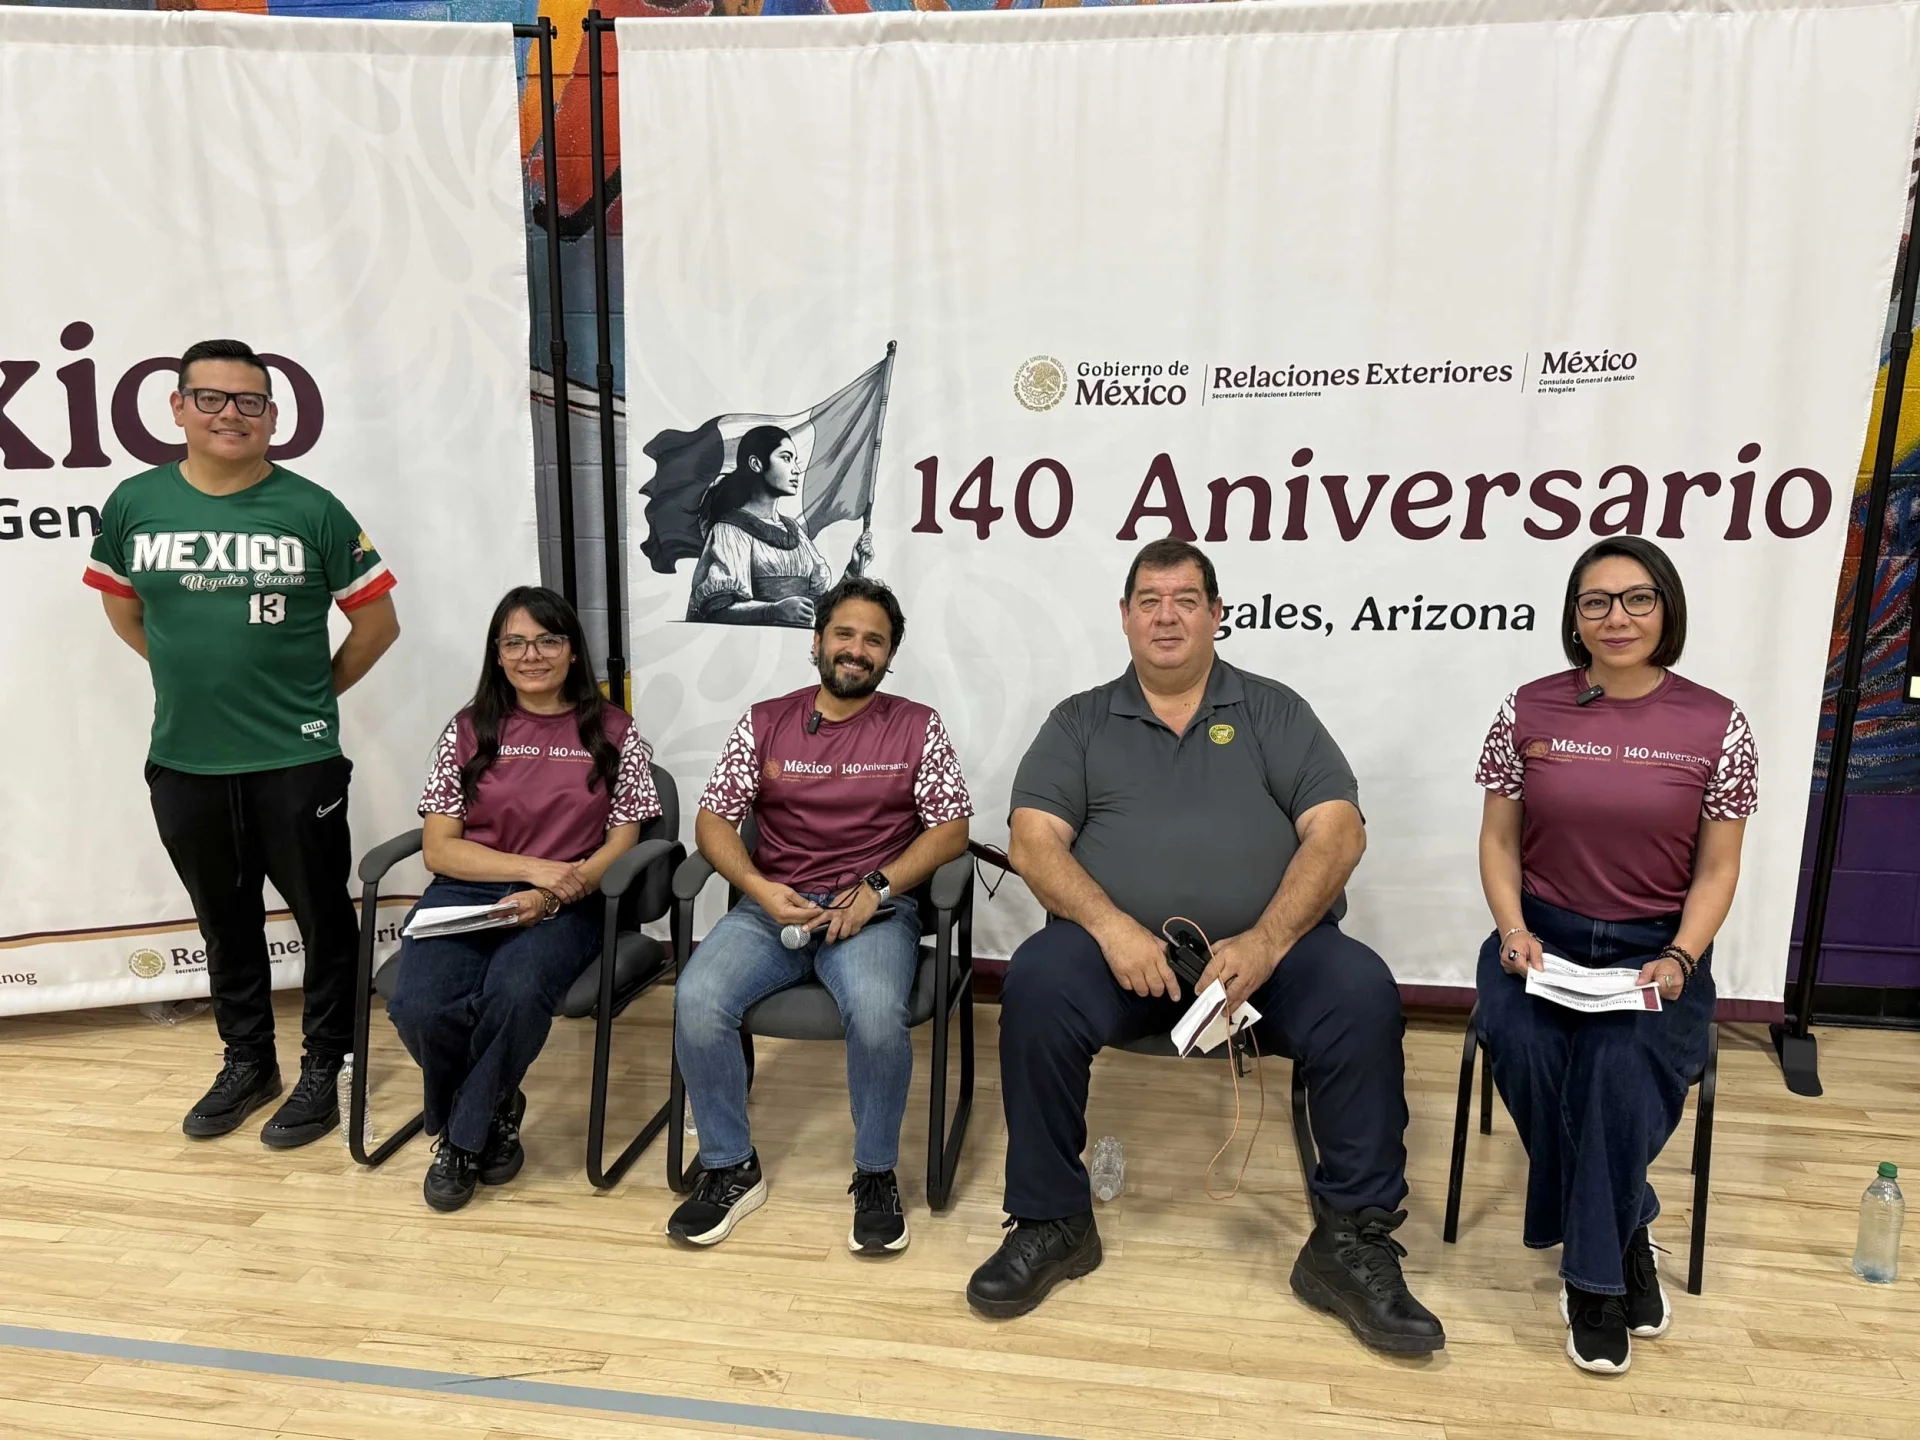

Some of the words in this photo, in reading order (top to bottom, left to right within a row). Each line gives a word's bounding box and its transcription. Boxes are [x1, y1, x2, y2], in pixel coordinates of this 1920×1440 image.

[1077, 361, 1163, 377] Gobierno
[1168, 360, 1189, 376] de
[1541, 349, 1637, 374] México
[1213, 364, 1360, 389] Relaciones
[1365, 360, 1513, 385] Exteriores
[1539, 378, 1575, 386] Consulado
[1575, 376, 1603, 384] General
[1612, 374, 1635, 382] México
[1074, 377, 1187, 406] México
[1288, 390, 1322, 398] Exteriores
[1548, 386, 1576, 395] Nogales
[911, 455, 1074, 541] 140
[1115, 442, 1833, 542] Aniversario
[131, 531, 306, 574] MEXICO
[179, 573, 249, 592] Nogales
[253, 571, 306, 588] Sonora
[248, 592, 287, 625] 13
[1213, 593, 1334, 641] gales,
[1350, 594, 1536, 631] Arizona
[548, 746, 569, 757] 140
[1551, 738, 1612, 756] México
[1623, 746, 1650, 759] 140
[1651, 749, 1711, 767] Aniversario
[783, 760, 832, 774] México
[841, 763, 861, 774] 140
[862, 761, 909, 771] Aniversario
